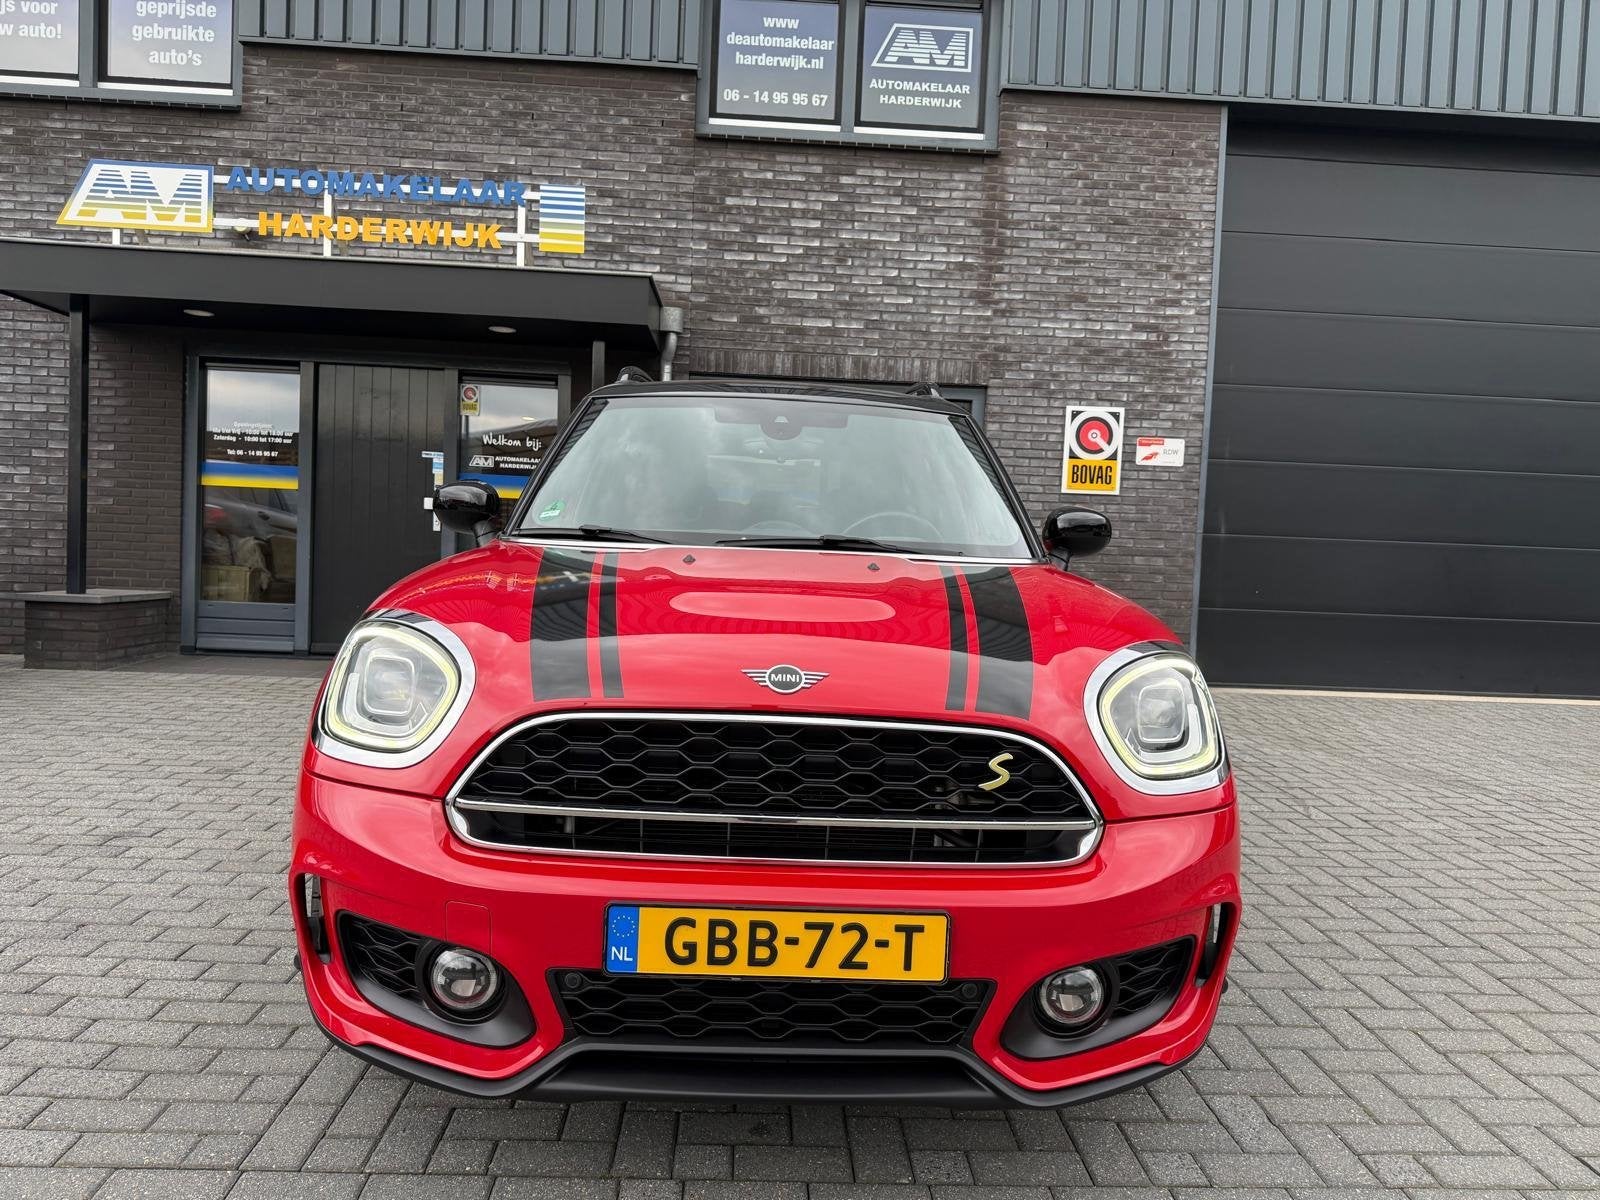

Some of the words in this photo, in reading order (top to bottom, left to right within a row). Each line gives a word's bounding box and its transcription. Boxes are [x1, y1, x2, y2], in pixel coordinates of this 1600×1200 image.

[21, 1, 58, 15] voor
[136, 0, 217, 19] geprijsde
[18, 22, 62, 39] auto!
[763, 16, 800, 29] www
[132, 23, 215, 42] gebruikte
[726, 32, 835, 51] deautomakelaar
[148, 49, 202, 66] auto's
[884, 29, 967, 67] AM
[735, 51, 824, 70] harderwijk.nl
[869, 78, 971, 94] AUTOMAKELAAR
[723, 88, 740, 101] 06
[753, 90, 769, 103] 14
[772, 91, 789, 104] 95
[792, 92, 808, 106] 95
[811, 94, 828, 107] 67
[879, 94, 962, 109] HARDERWIJK
[76, 169, 203, 223] AM
[226, 166, 527, 207] AUTOMAKELAAR
[258, 211, 502, 249] HARDERWIJK
[482, 432, 521, 447] Welkom
[526, 437, 542, 451] bij:
[1071, 464, 1113, 485] BOVAG
[770, 673, 800, 682] MINI
[978, 752, 1014, 790] S
[664, 916, 925, 972] GBB-72-T
[611, 946, 633, 962] NL
